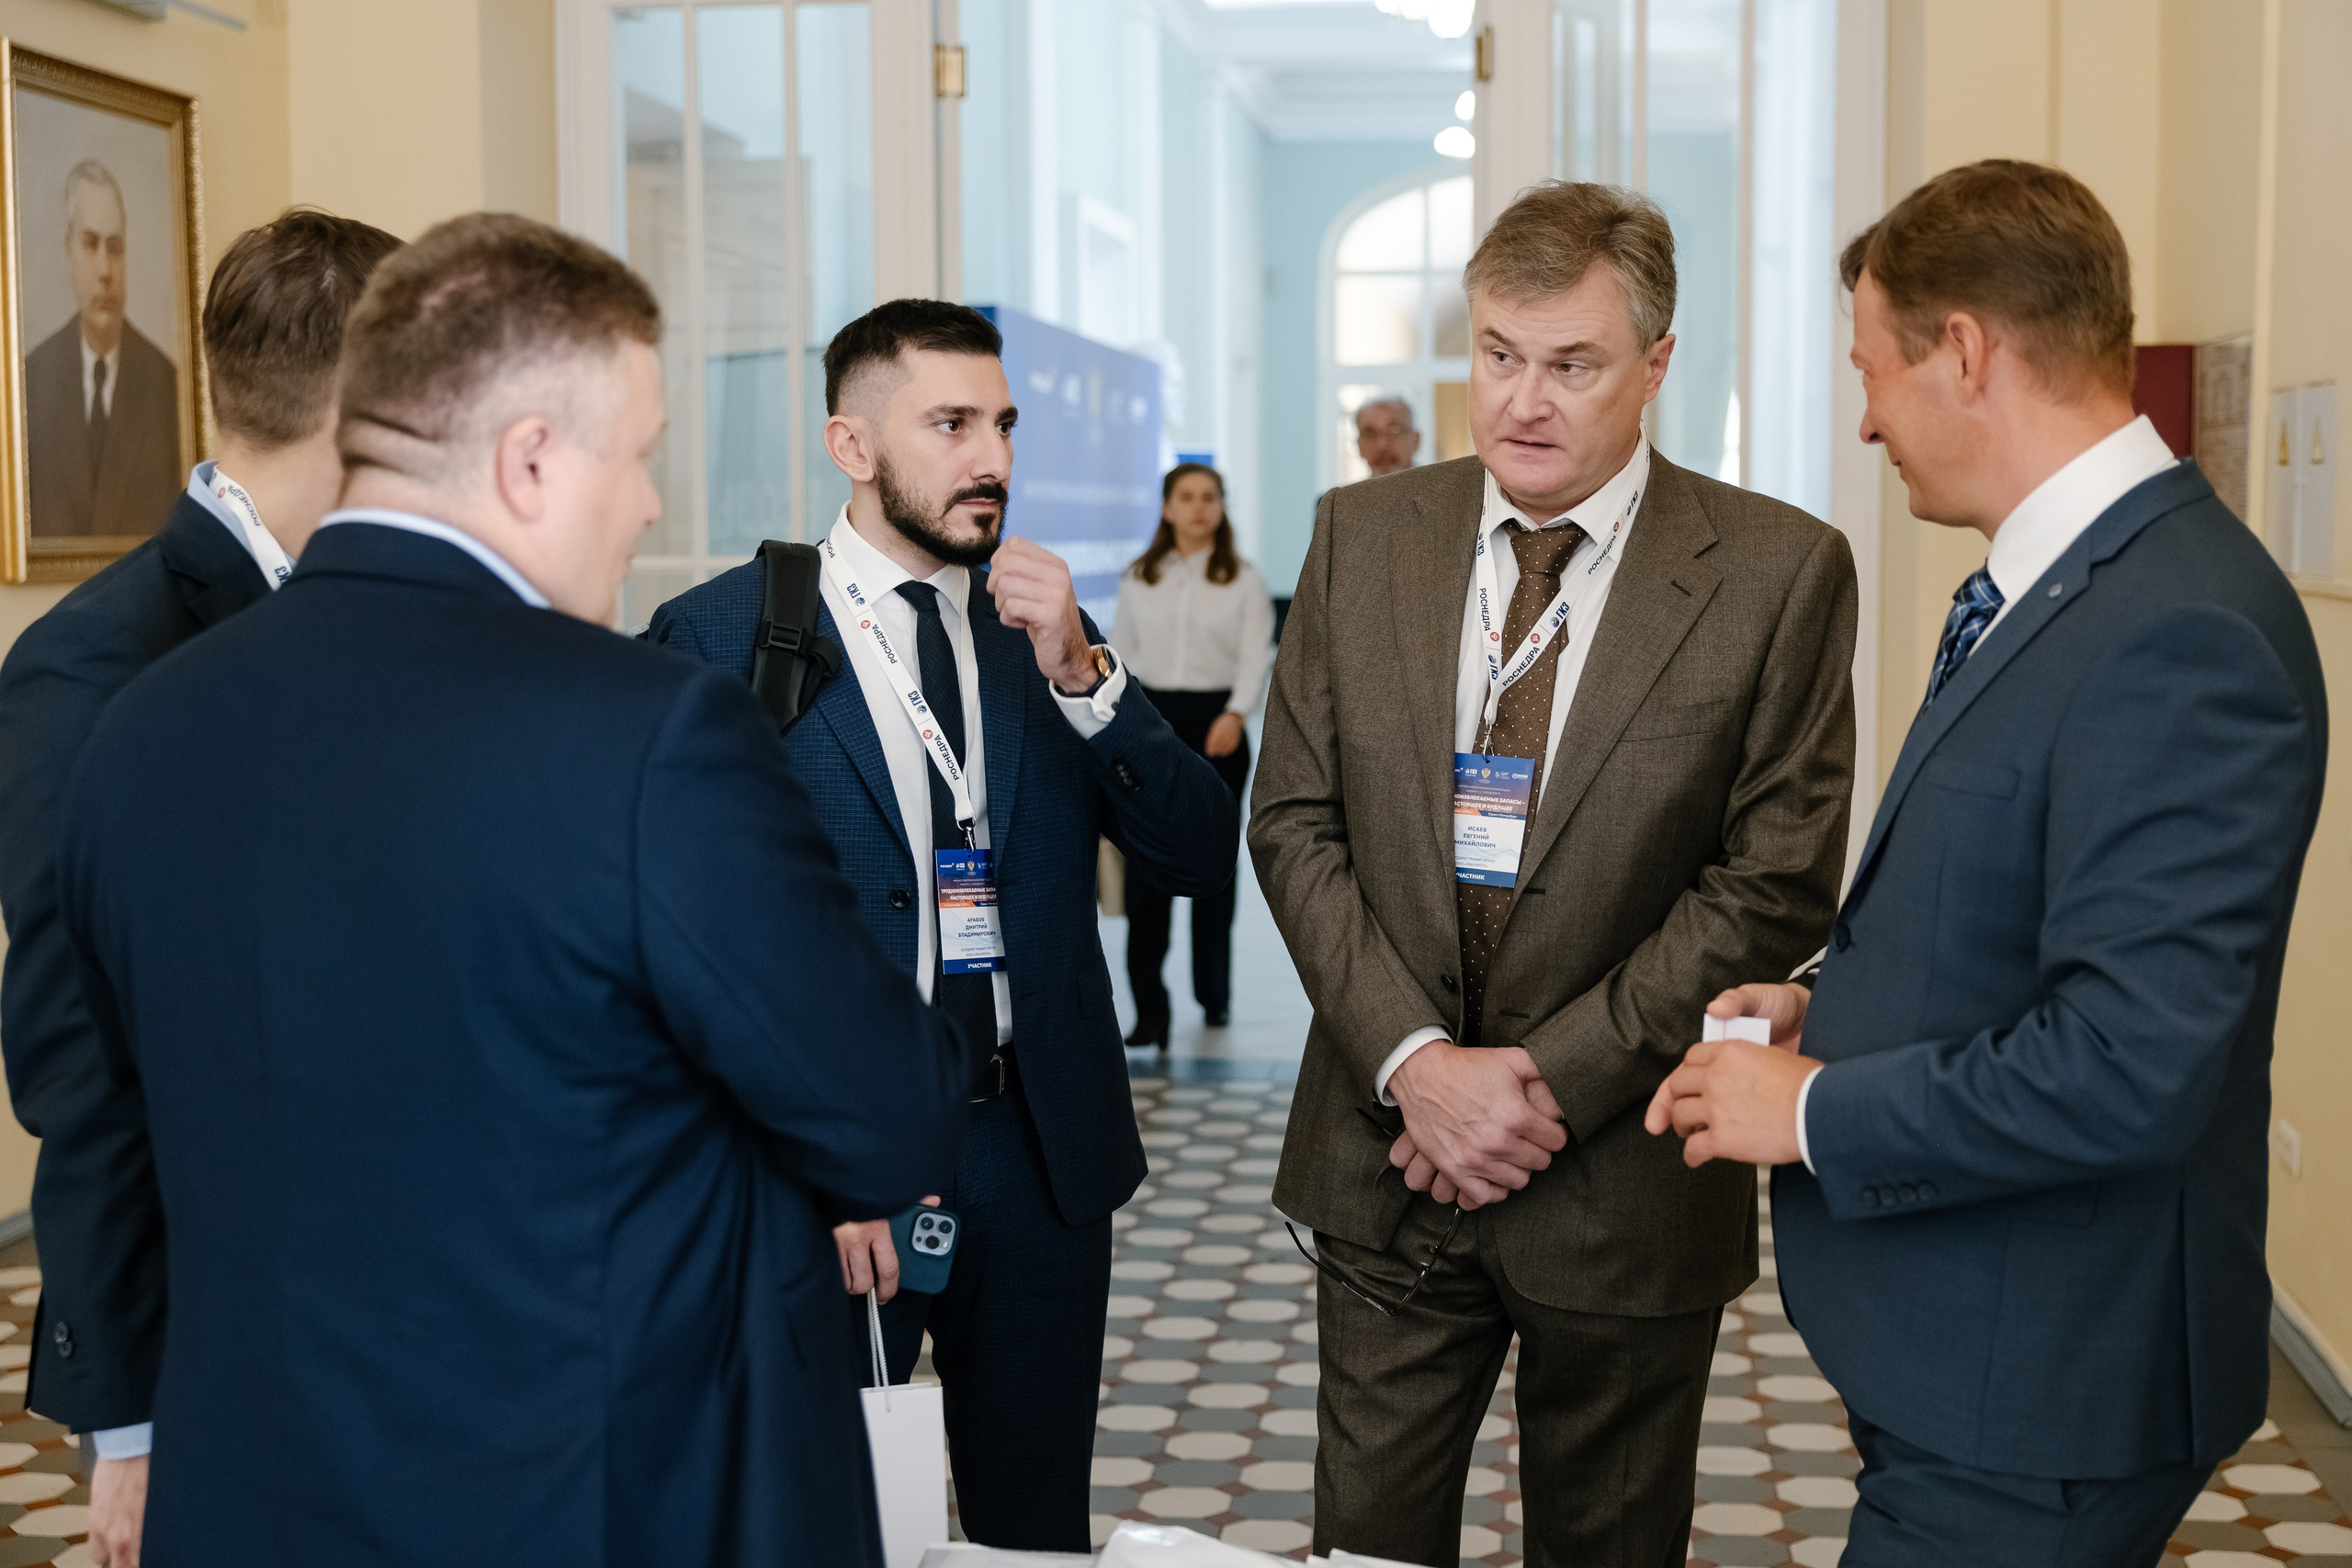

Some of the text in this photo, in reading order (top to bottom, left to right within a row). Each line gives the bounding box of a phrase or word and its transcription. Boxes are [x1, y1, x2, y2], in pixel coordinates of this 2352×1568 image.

[228, 484, 261, 526] РОСНЕДРА
[1630, 491, 1639, 508] ГКЗ
[1588, 536, 1617, 575] РОСНЕДРА
[274, 565, 291, 585] КЗ
[846, 582, 862, 599] ГКЗ
[1478, 587, 1491, 631] РОСНЕДРА
[1555, 601, 1570, 620] ГКЗ
[871, 624, 898, 664] РОСНЕДРА
[1489, 664, 1498, 681] ГКЗ
[1502, 646, 1540, 687] РОСНЕДРА
[908, 690, 922, 706] ГКЗ
[934, 734, 959, 781] РОСНЕДРА
[1454, 840, 1496, 848] МИХАЙЛОВИЧ
